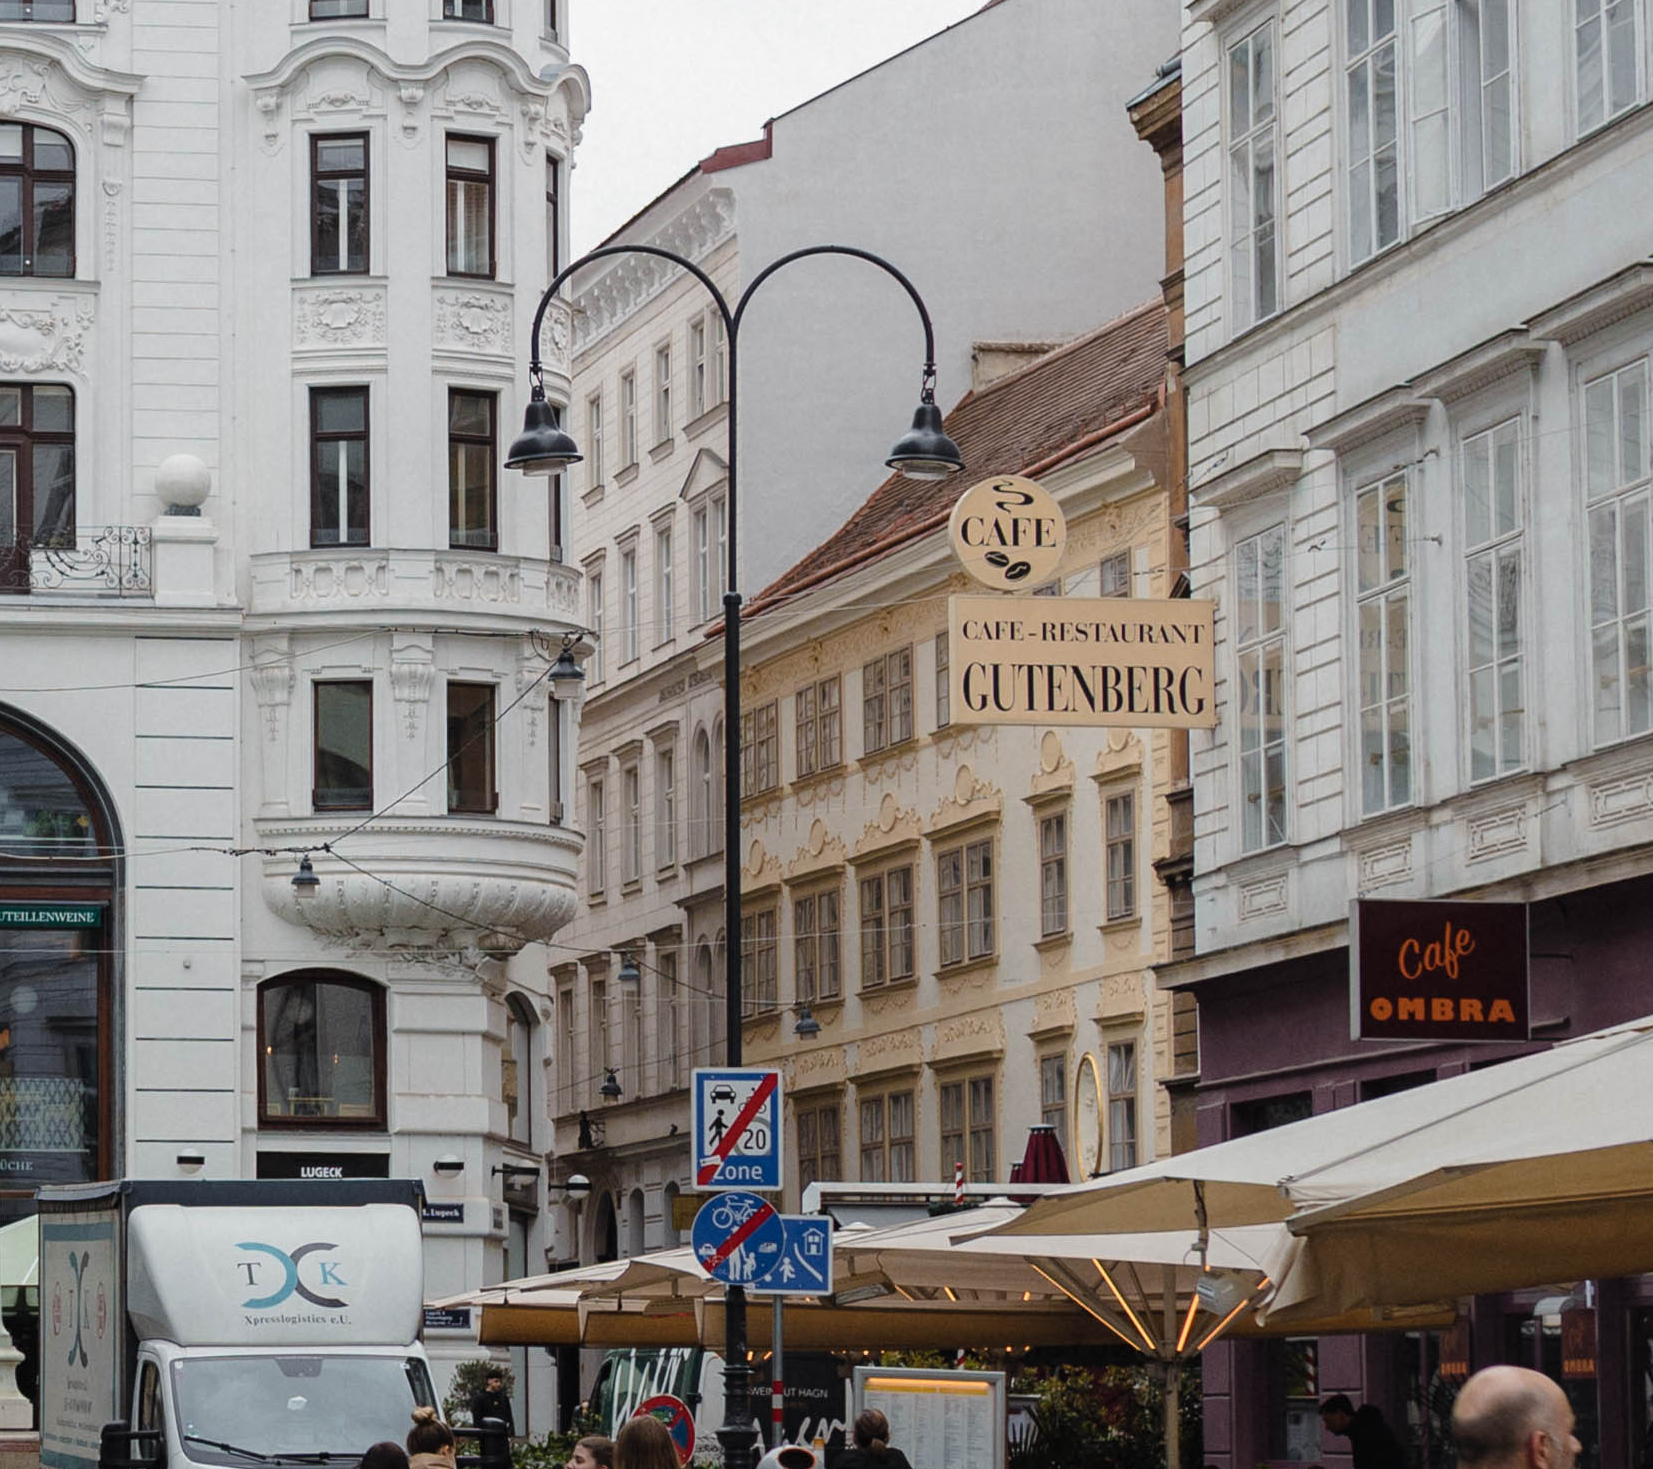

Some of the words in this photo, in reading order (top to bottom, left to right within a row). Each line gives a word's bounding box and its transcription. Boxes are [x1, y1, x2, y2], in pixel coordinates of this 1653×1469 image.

[960, 515, 1057, 549] CAFE
[961, 661, 1206, 716] GUTENBERG
[1398, 921, 1475, 980] Cafe
[1369, 997, 1516, 1024] OMBRA
[743, 1128, 767, 1150] 20
[300, 1166, 343, 1179] LUGECK
[712, 1163, 763, 1180] Zone
[244, 1314, 327, 1327] Xpresslogistics
